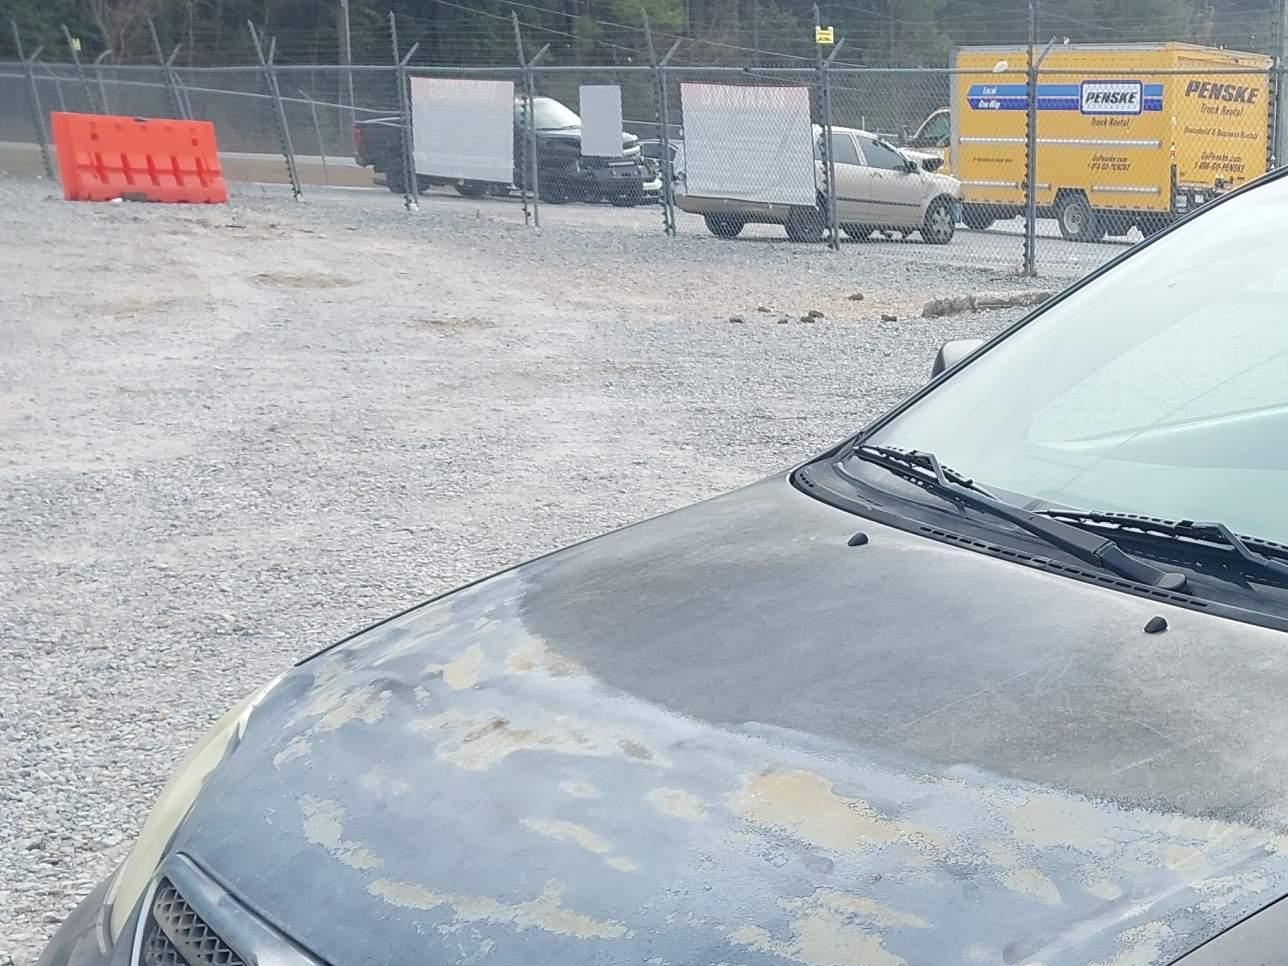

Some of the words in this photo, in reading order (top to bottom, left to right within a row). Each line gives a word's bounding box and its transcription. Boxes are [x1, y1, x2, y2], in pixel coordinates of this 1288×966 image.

[1085, 91, 1138, 104] PENSKE
[1185, 79, 1259, 104] PENSKE
[1200, 103, 1219, 114] Truck
[1220, 105, 1244, 117] Rental
[1090, 117, 1107, 127] Truck
[1108, 117, 1130, 127] Rental
